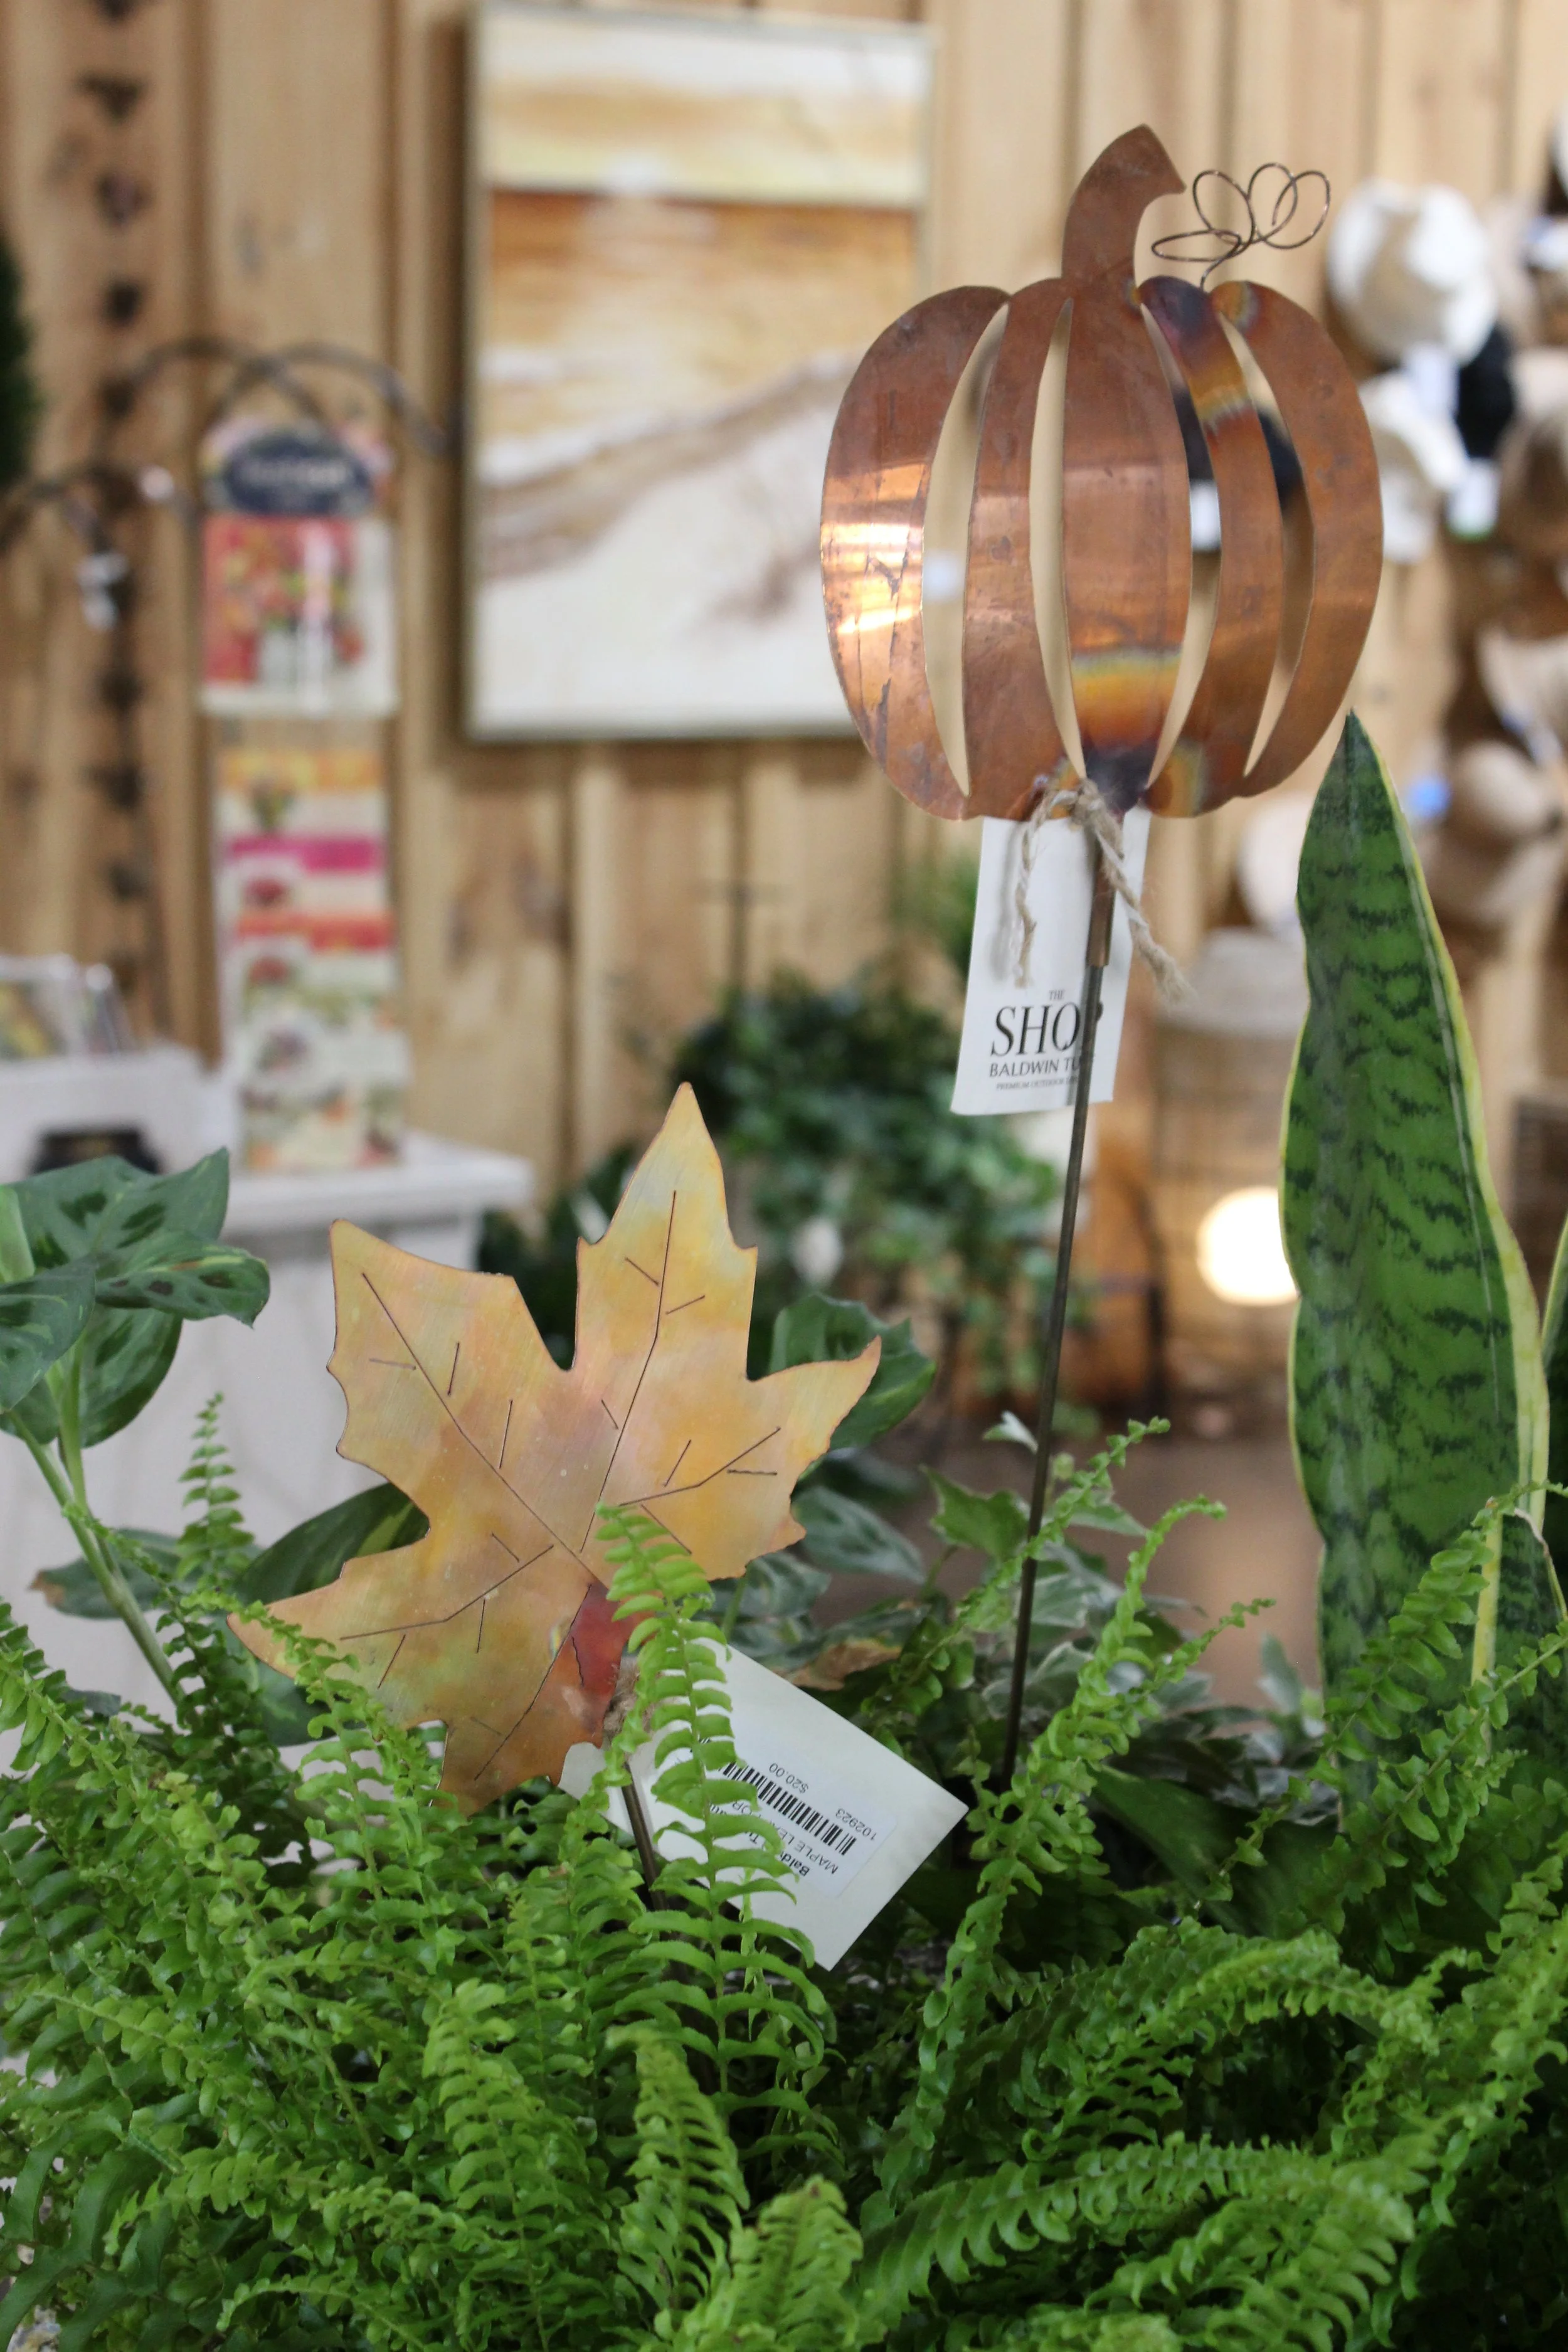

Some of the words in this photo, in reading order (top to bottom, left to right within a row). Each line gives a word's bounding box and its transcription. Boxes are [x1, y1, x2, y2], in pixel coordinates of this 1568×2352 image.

[1049, 990, 1064, 1000] THE
[990, 1002, 1101, 1056] SHO
[990, 1059, 1059, 1077] BALDWIN
[768, 1762, 809, 1794] $20.00
[835, 1808, 877, 1841] 102923
[795, 1840, 839, 1875] MAPLE
